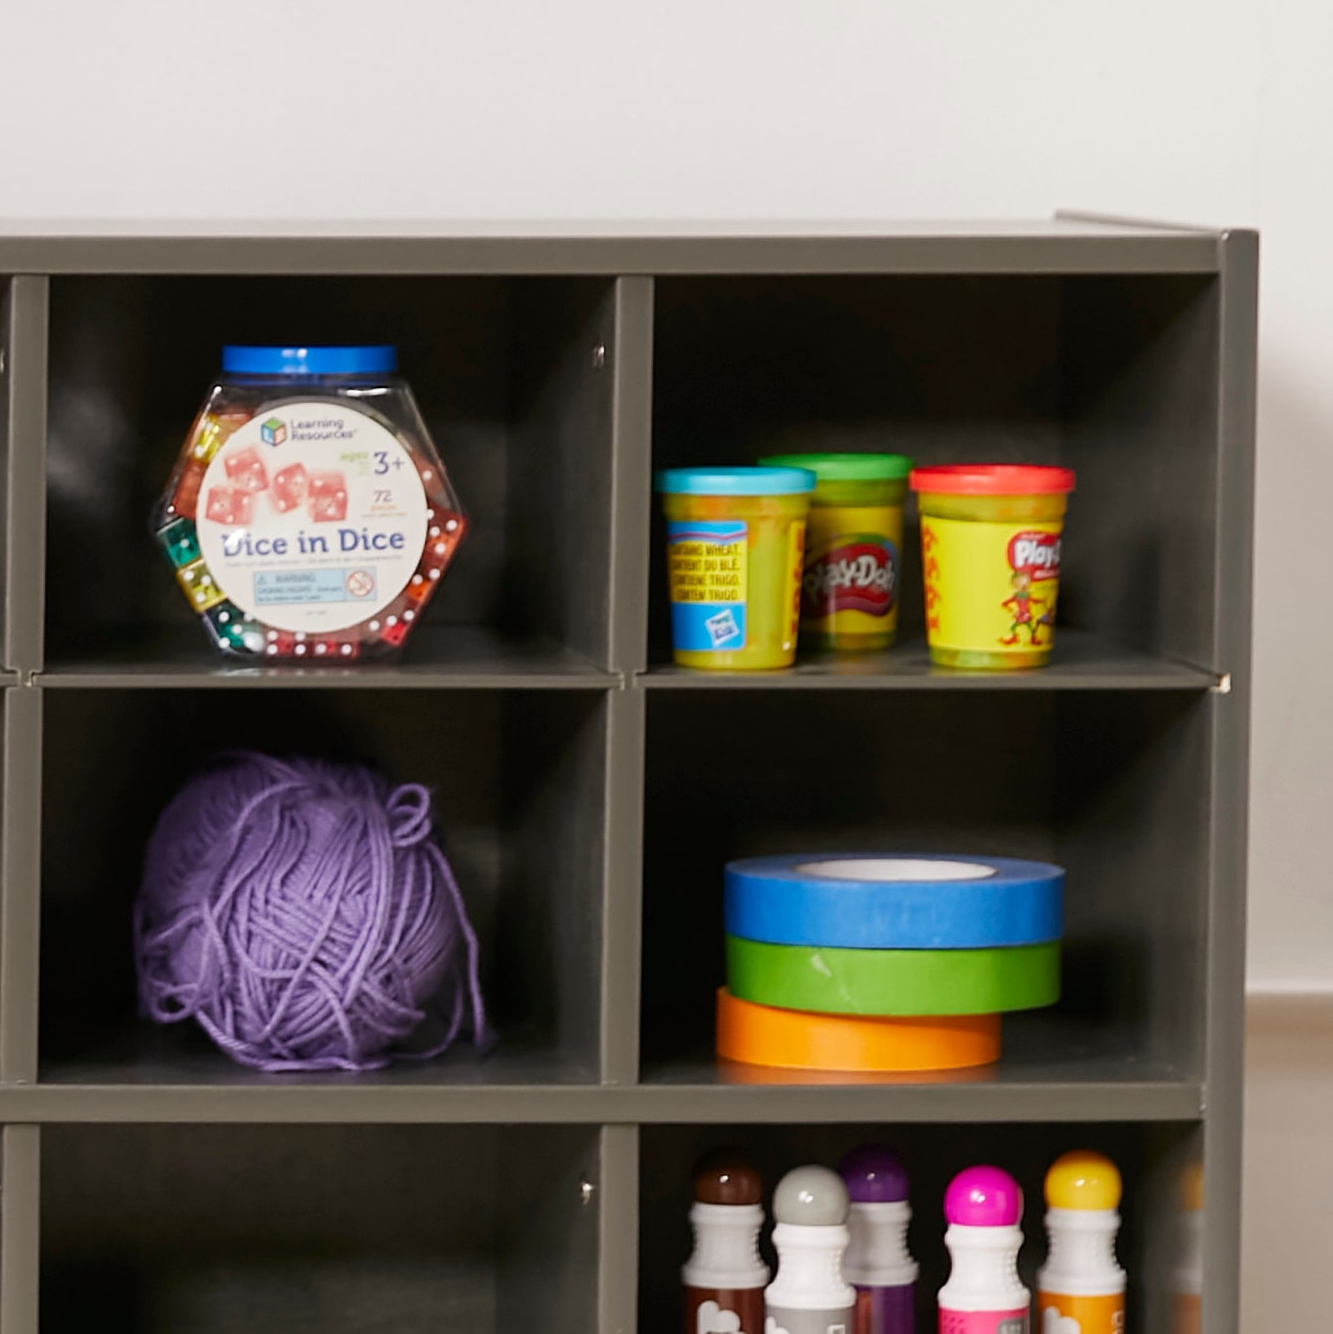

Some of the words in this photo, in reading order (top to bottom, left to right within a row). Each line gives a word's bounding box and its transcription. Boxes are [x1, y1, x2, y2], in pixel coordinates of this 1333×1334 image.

[290, 417, 344, 430] Learning
[290, 429, 354, 441] Resources
[373, 451, 406, 475] 3+
[373, 490, 392, 503] 72
[221, 529, 288, 557] Dice
[298, 530, 329, 554] in
[338, 527, 405, 552] Dice
